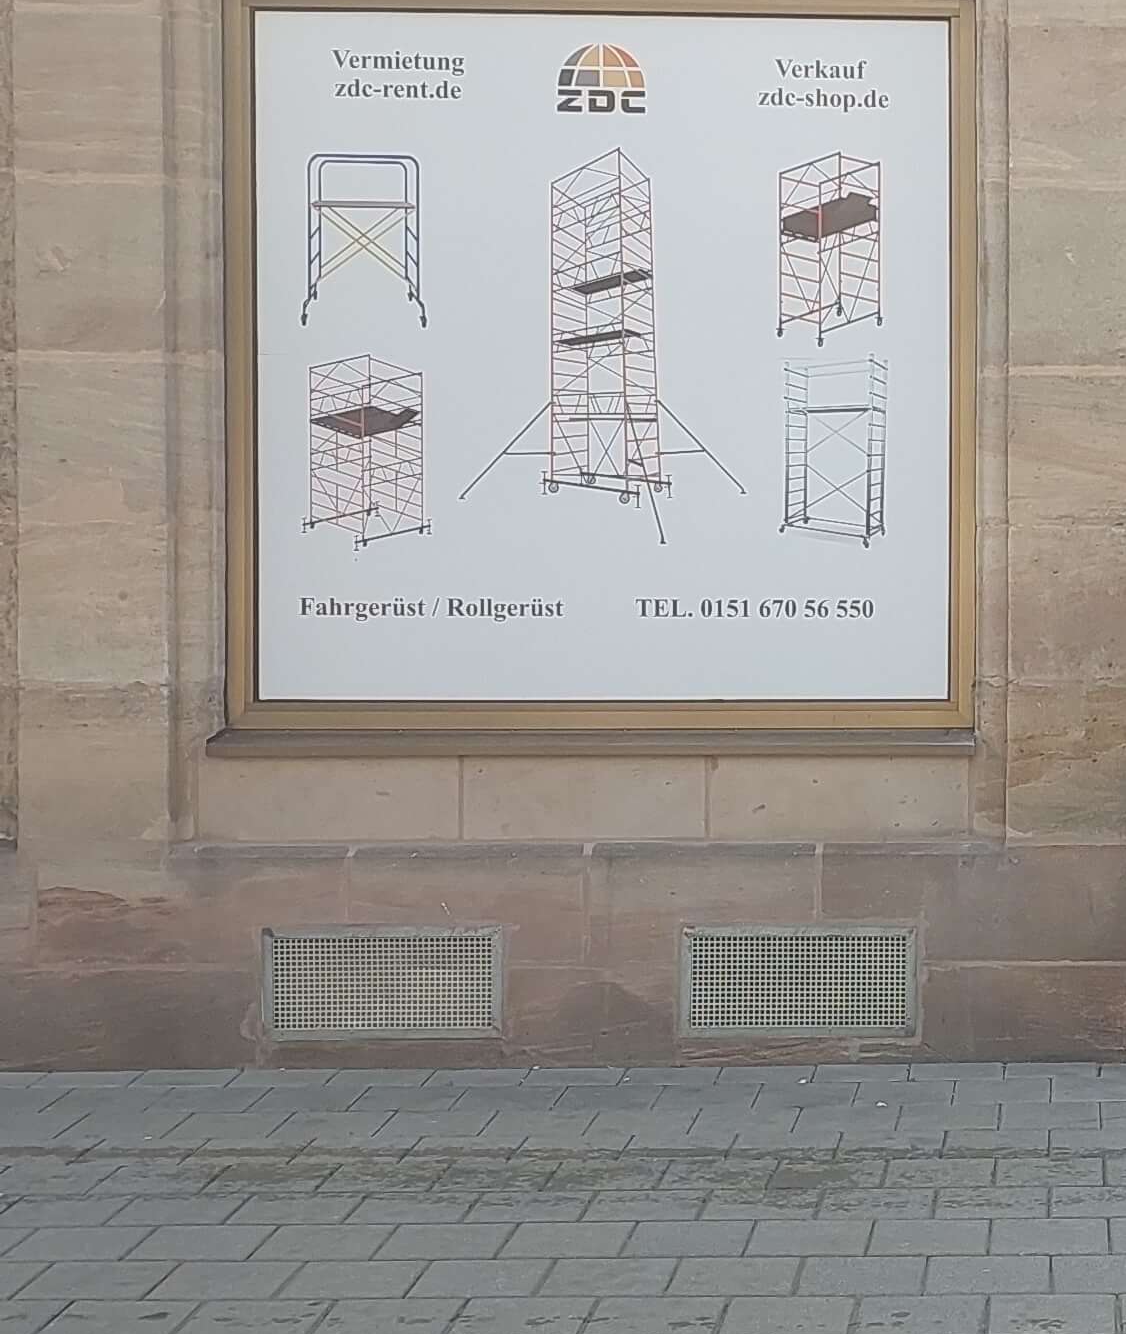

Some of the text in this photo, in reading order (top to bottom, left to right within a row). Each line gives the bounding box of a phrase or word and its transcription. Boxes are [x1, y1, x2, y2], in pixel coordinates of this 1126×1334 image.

[332, 49, 465, 76] Vermietung
[775, 58, 868, 80] Verkauf
[334, 79, 462, 100] zdc-rent.de
[556, 88, 646, 114] ZDC
[758, 87, 889, 113] zdc-shop.de
[299, 597, 565, 623] Fahrgerüst / Rollgerüst
[635, 598, 874, 619] TEL. 0151 670 56 550
